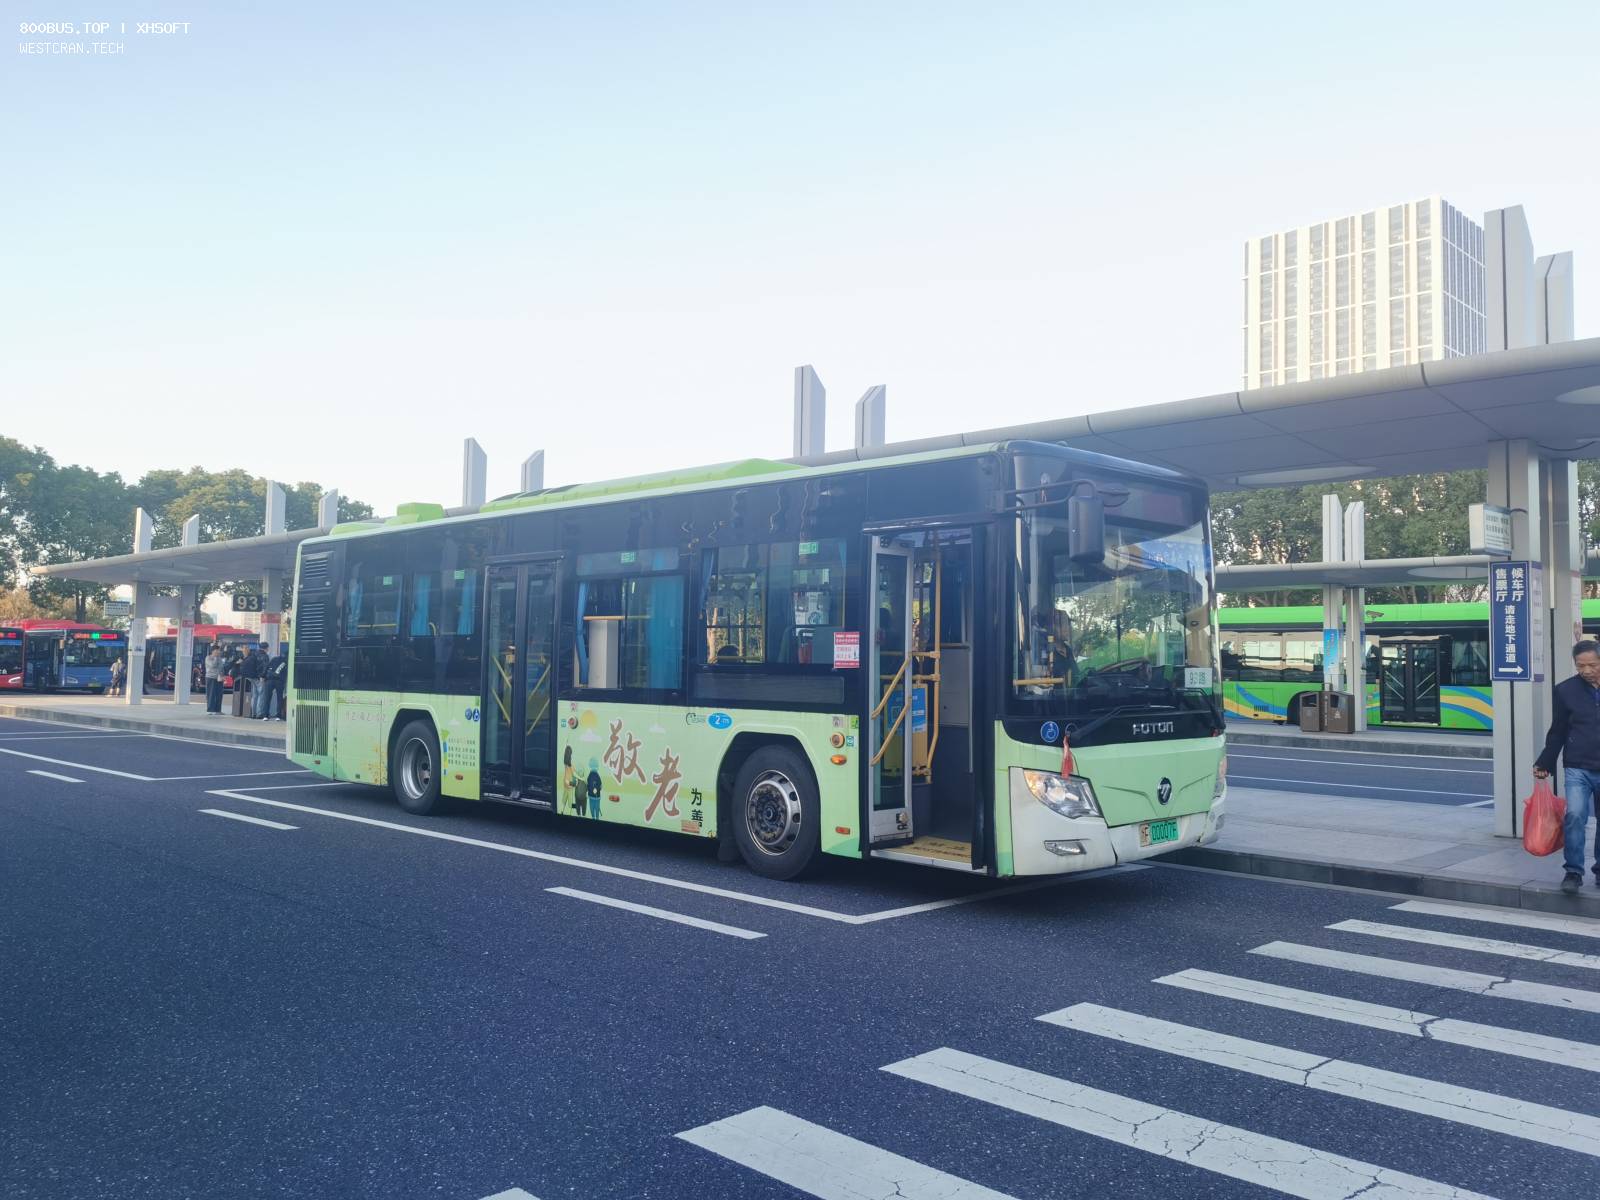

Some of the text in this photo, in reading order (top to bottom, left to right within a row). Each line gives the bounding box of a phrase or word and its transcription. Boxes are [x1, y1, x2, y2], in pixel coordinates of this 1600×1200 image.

[1495, 568, 1508, 602] 售票厅
[1511, 568, 1524, 602] 候车厅
[237, 595, 259, 610] 93
[1505, 605, 1516, 663] 请走地下通道
[1132, 721, 1174, 735] FOTON
[603, 719, 682, 822] 敬老
